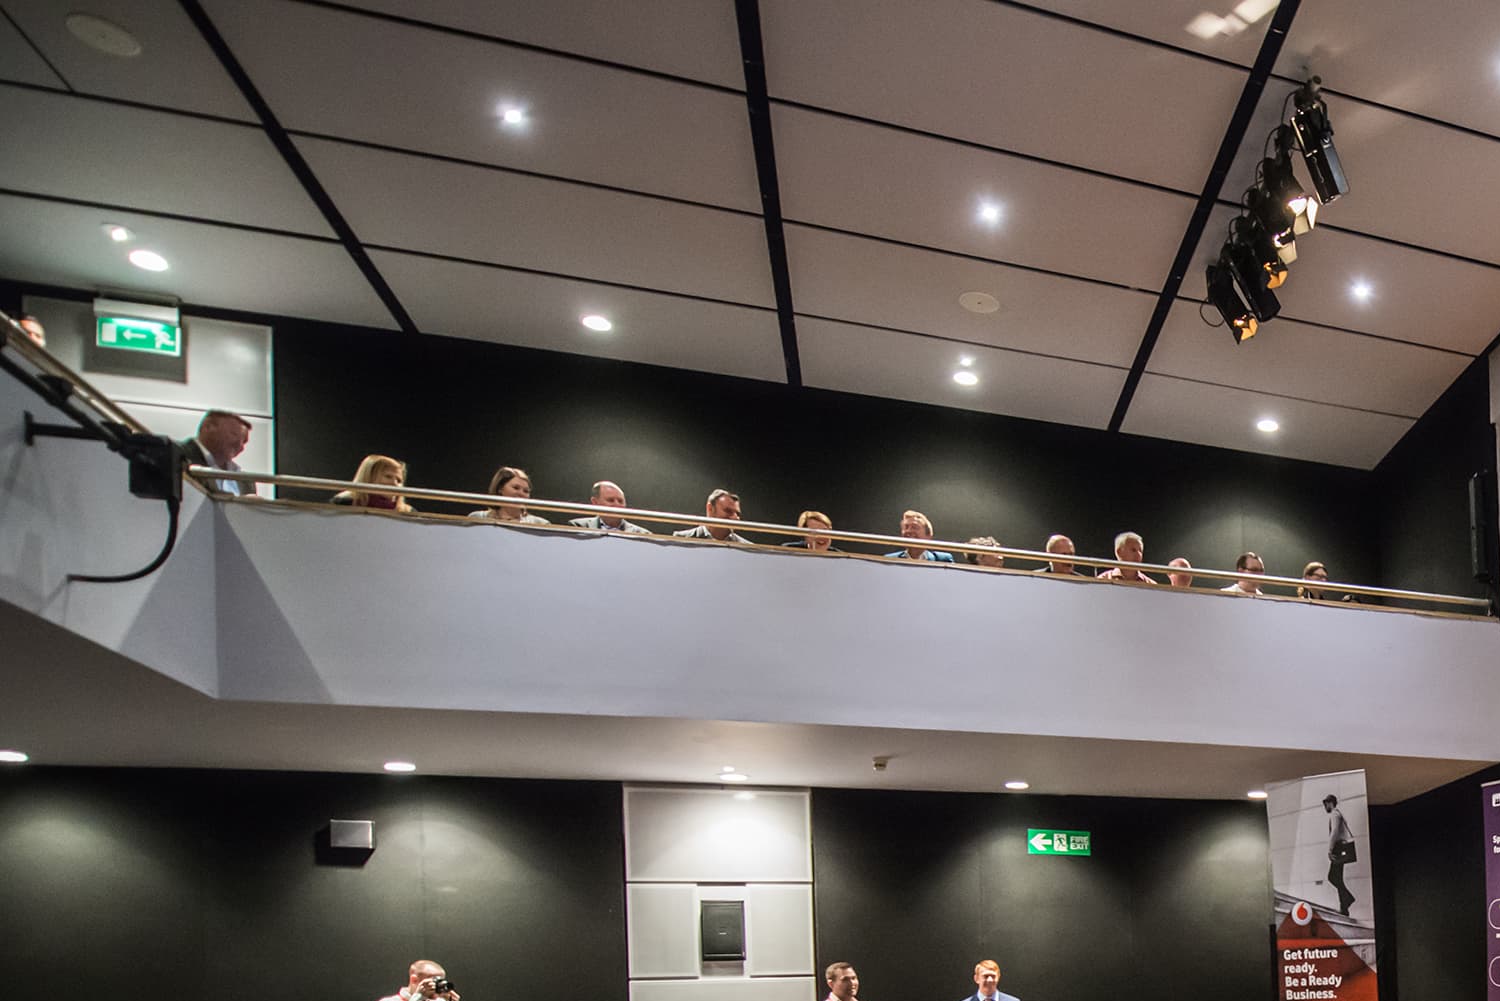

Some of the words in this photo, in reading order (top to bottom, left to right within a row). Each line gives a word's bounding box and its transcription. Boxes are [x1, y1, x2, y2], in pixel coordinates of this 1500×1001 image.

[1070, 836, 1088, 844] FIRE
[1283, 949, 1302, 960] Get
[1303, 948, 1338, 960] future
[1284, 961, 1318, 975] ready.
[1284, 976, 1299, 987] Be
[1300, 977, 1307, 987] a
[1308, 974, 1342, 988] Ready
[1285, 988, 1337, 1000] Business.
